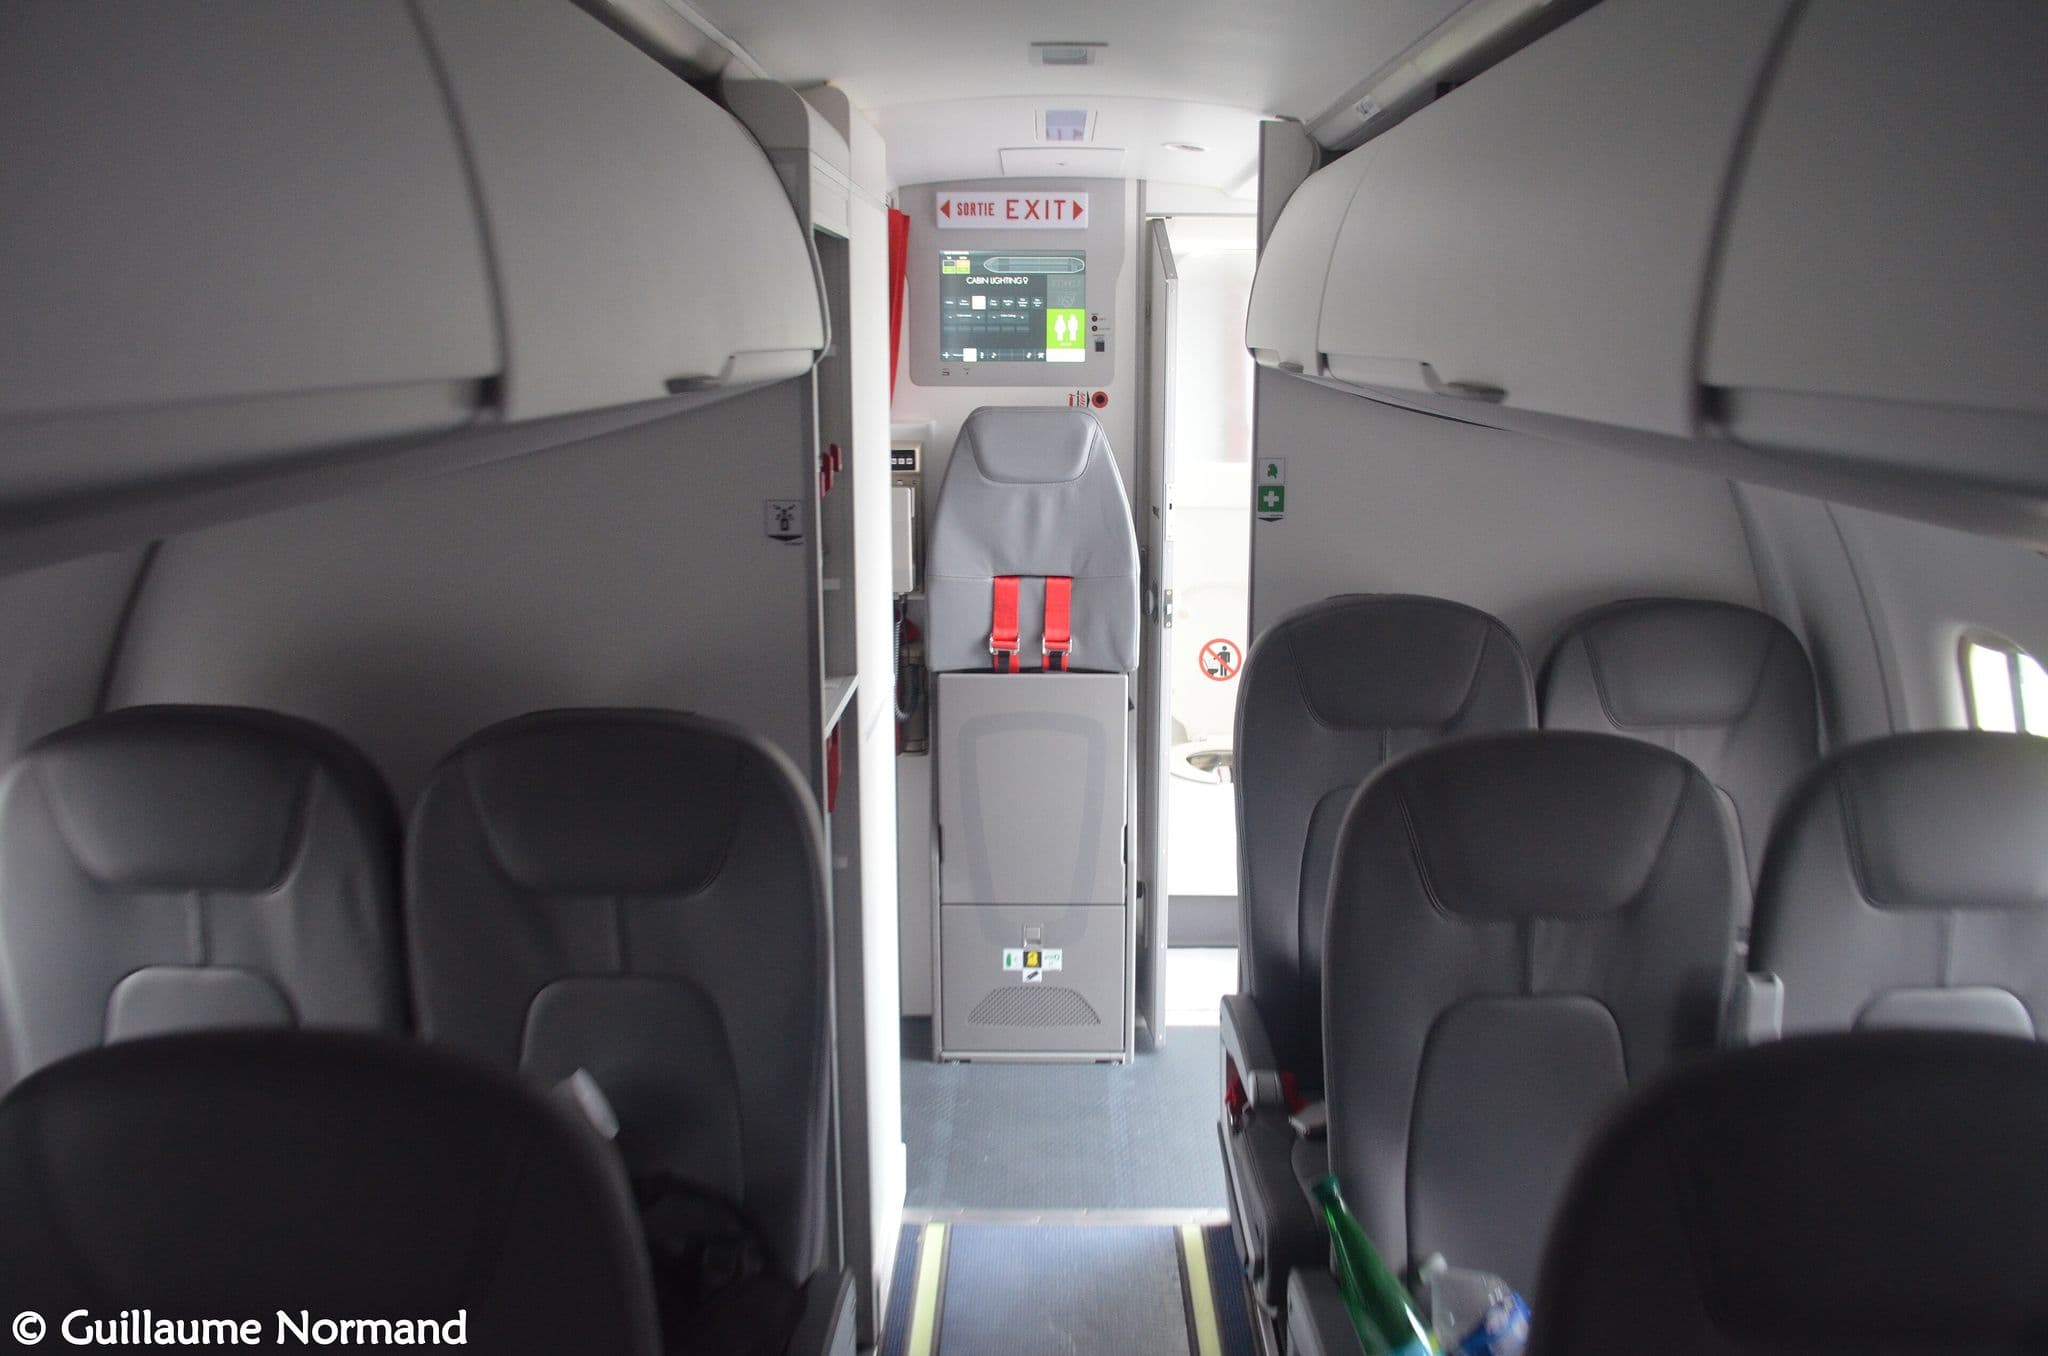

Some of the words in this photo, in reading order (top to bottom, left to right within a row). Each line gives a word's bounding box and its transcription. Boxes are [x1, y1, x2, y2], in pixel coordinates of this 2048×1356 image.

[957, 202, 995, 217] SORTIE
[1006, 199, 1067, 220] EXIT
[966, 276, 989, 285] CABIN
[990, 276, 1023, 285] LIGHTING
